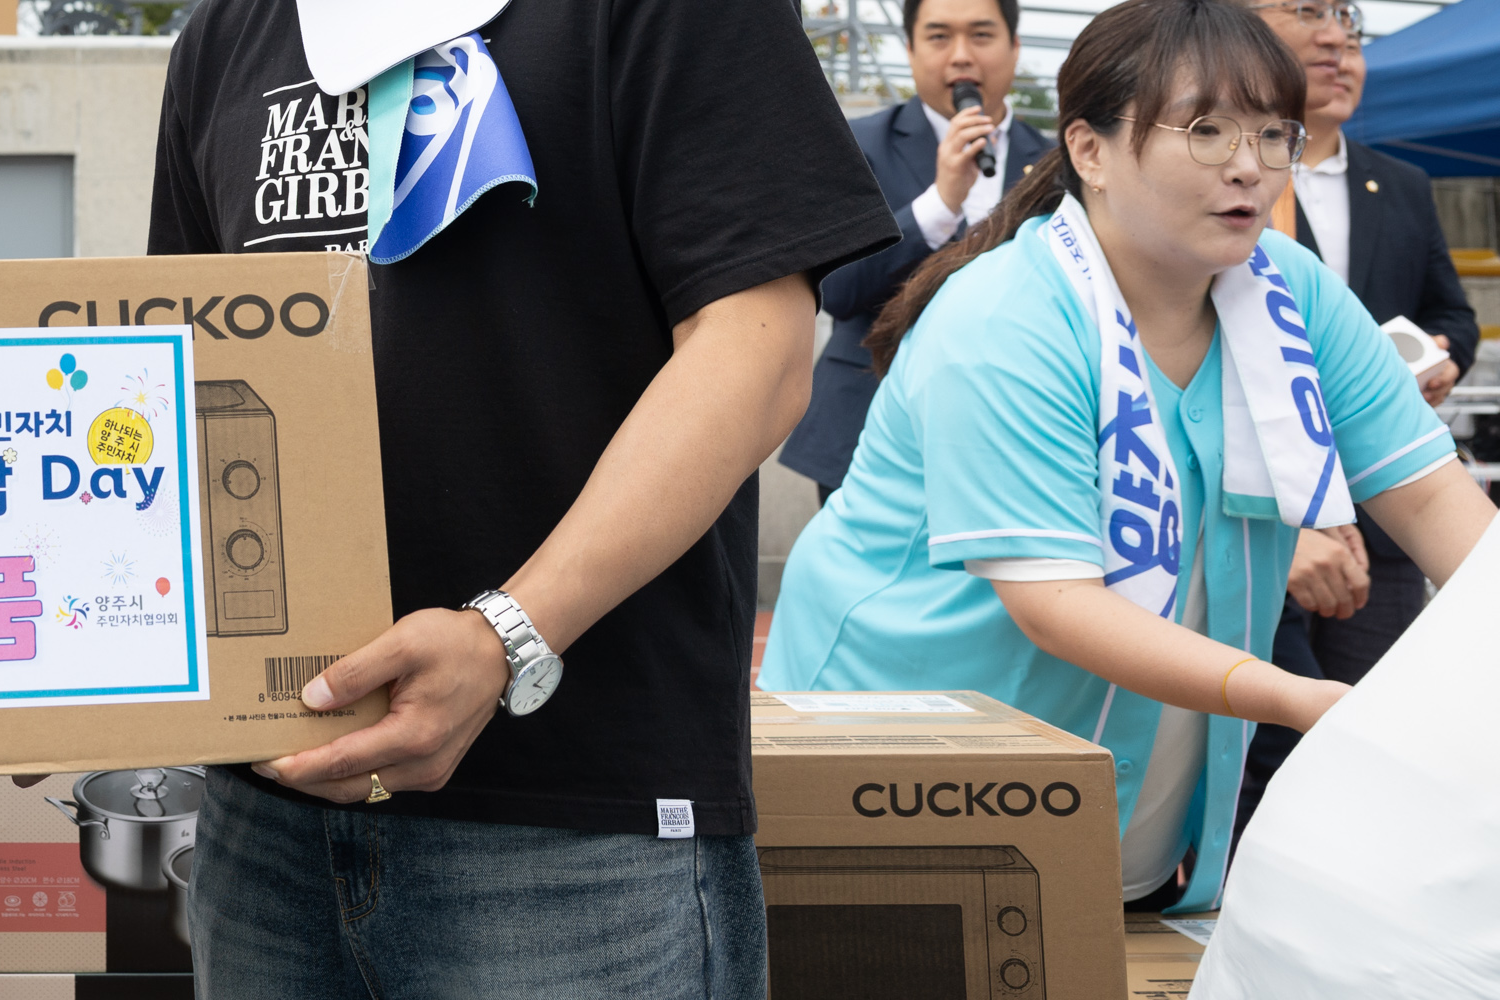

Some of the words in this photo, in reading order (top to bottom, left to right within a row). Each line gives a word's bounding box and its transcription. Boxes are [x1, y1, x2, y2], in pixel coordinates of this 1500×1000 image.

[104, 418, 143, 442] 하나되는
[96, 441, 136, 464] 주민자치
[41, 454, 166, 511] Day
[94, 594, 144, 612] 양주시
[96, 612, 179, 628] 주민자치협의회
[852, 781, 1082, 818] CUCKOO
